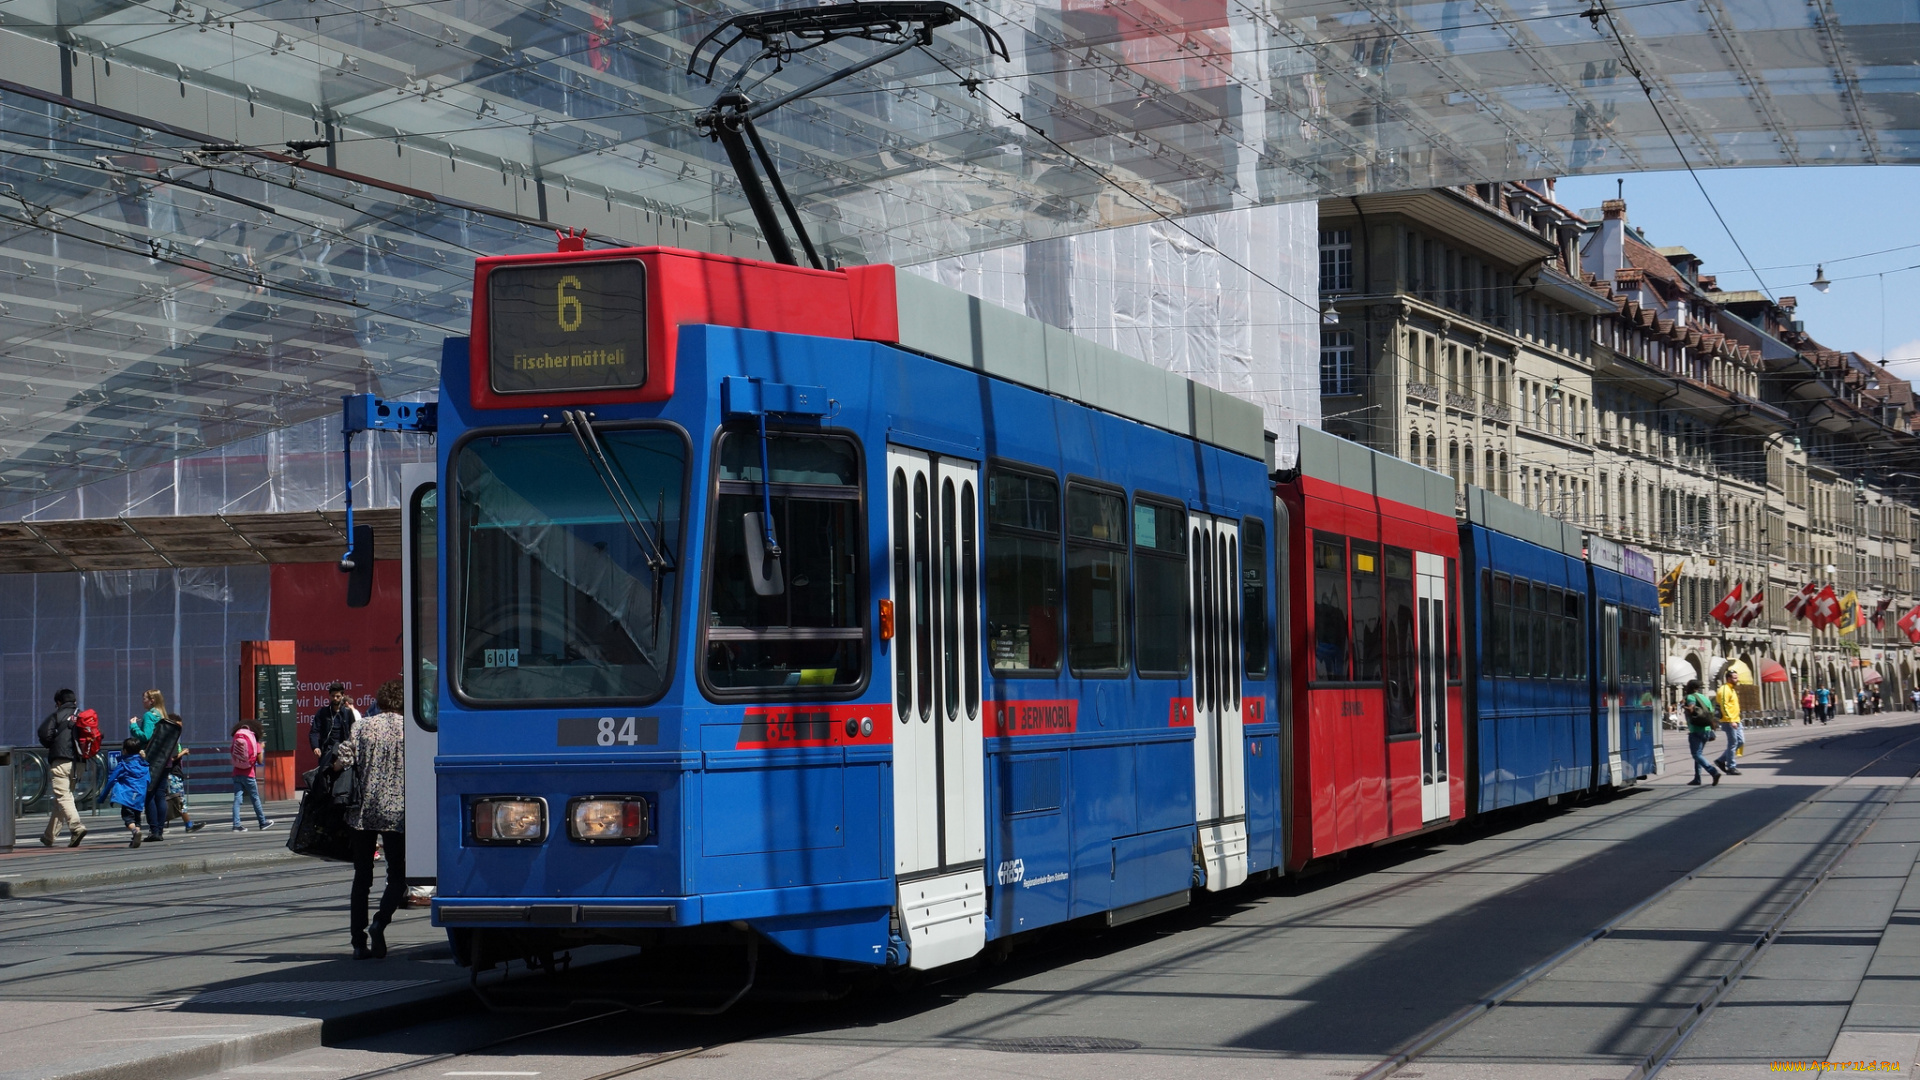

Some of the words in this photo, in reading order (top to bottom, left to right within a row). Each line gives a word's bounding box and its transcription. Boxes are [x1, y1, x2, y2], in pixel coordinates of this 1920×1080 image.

[557, 275, 582, 332] 6
[513, 348, 625, 371] Fischermätteli
[486, 653, 516, 663] 604
[296, 679, 352, 691] Renovaon
[356, 694, 376, 706] offe
[596, 716, 638, 746] 84
[766, 712, 796, 742] 84
